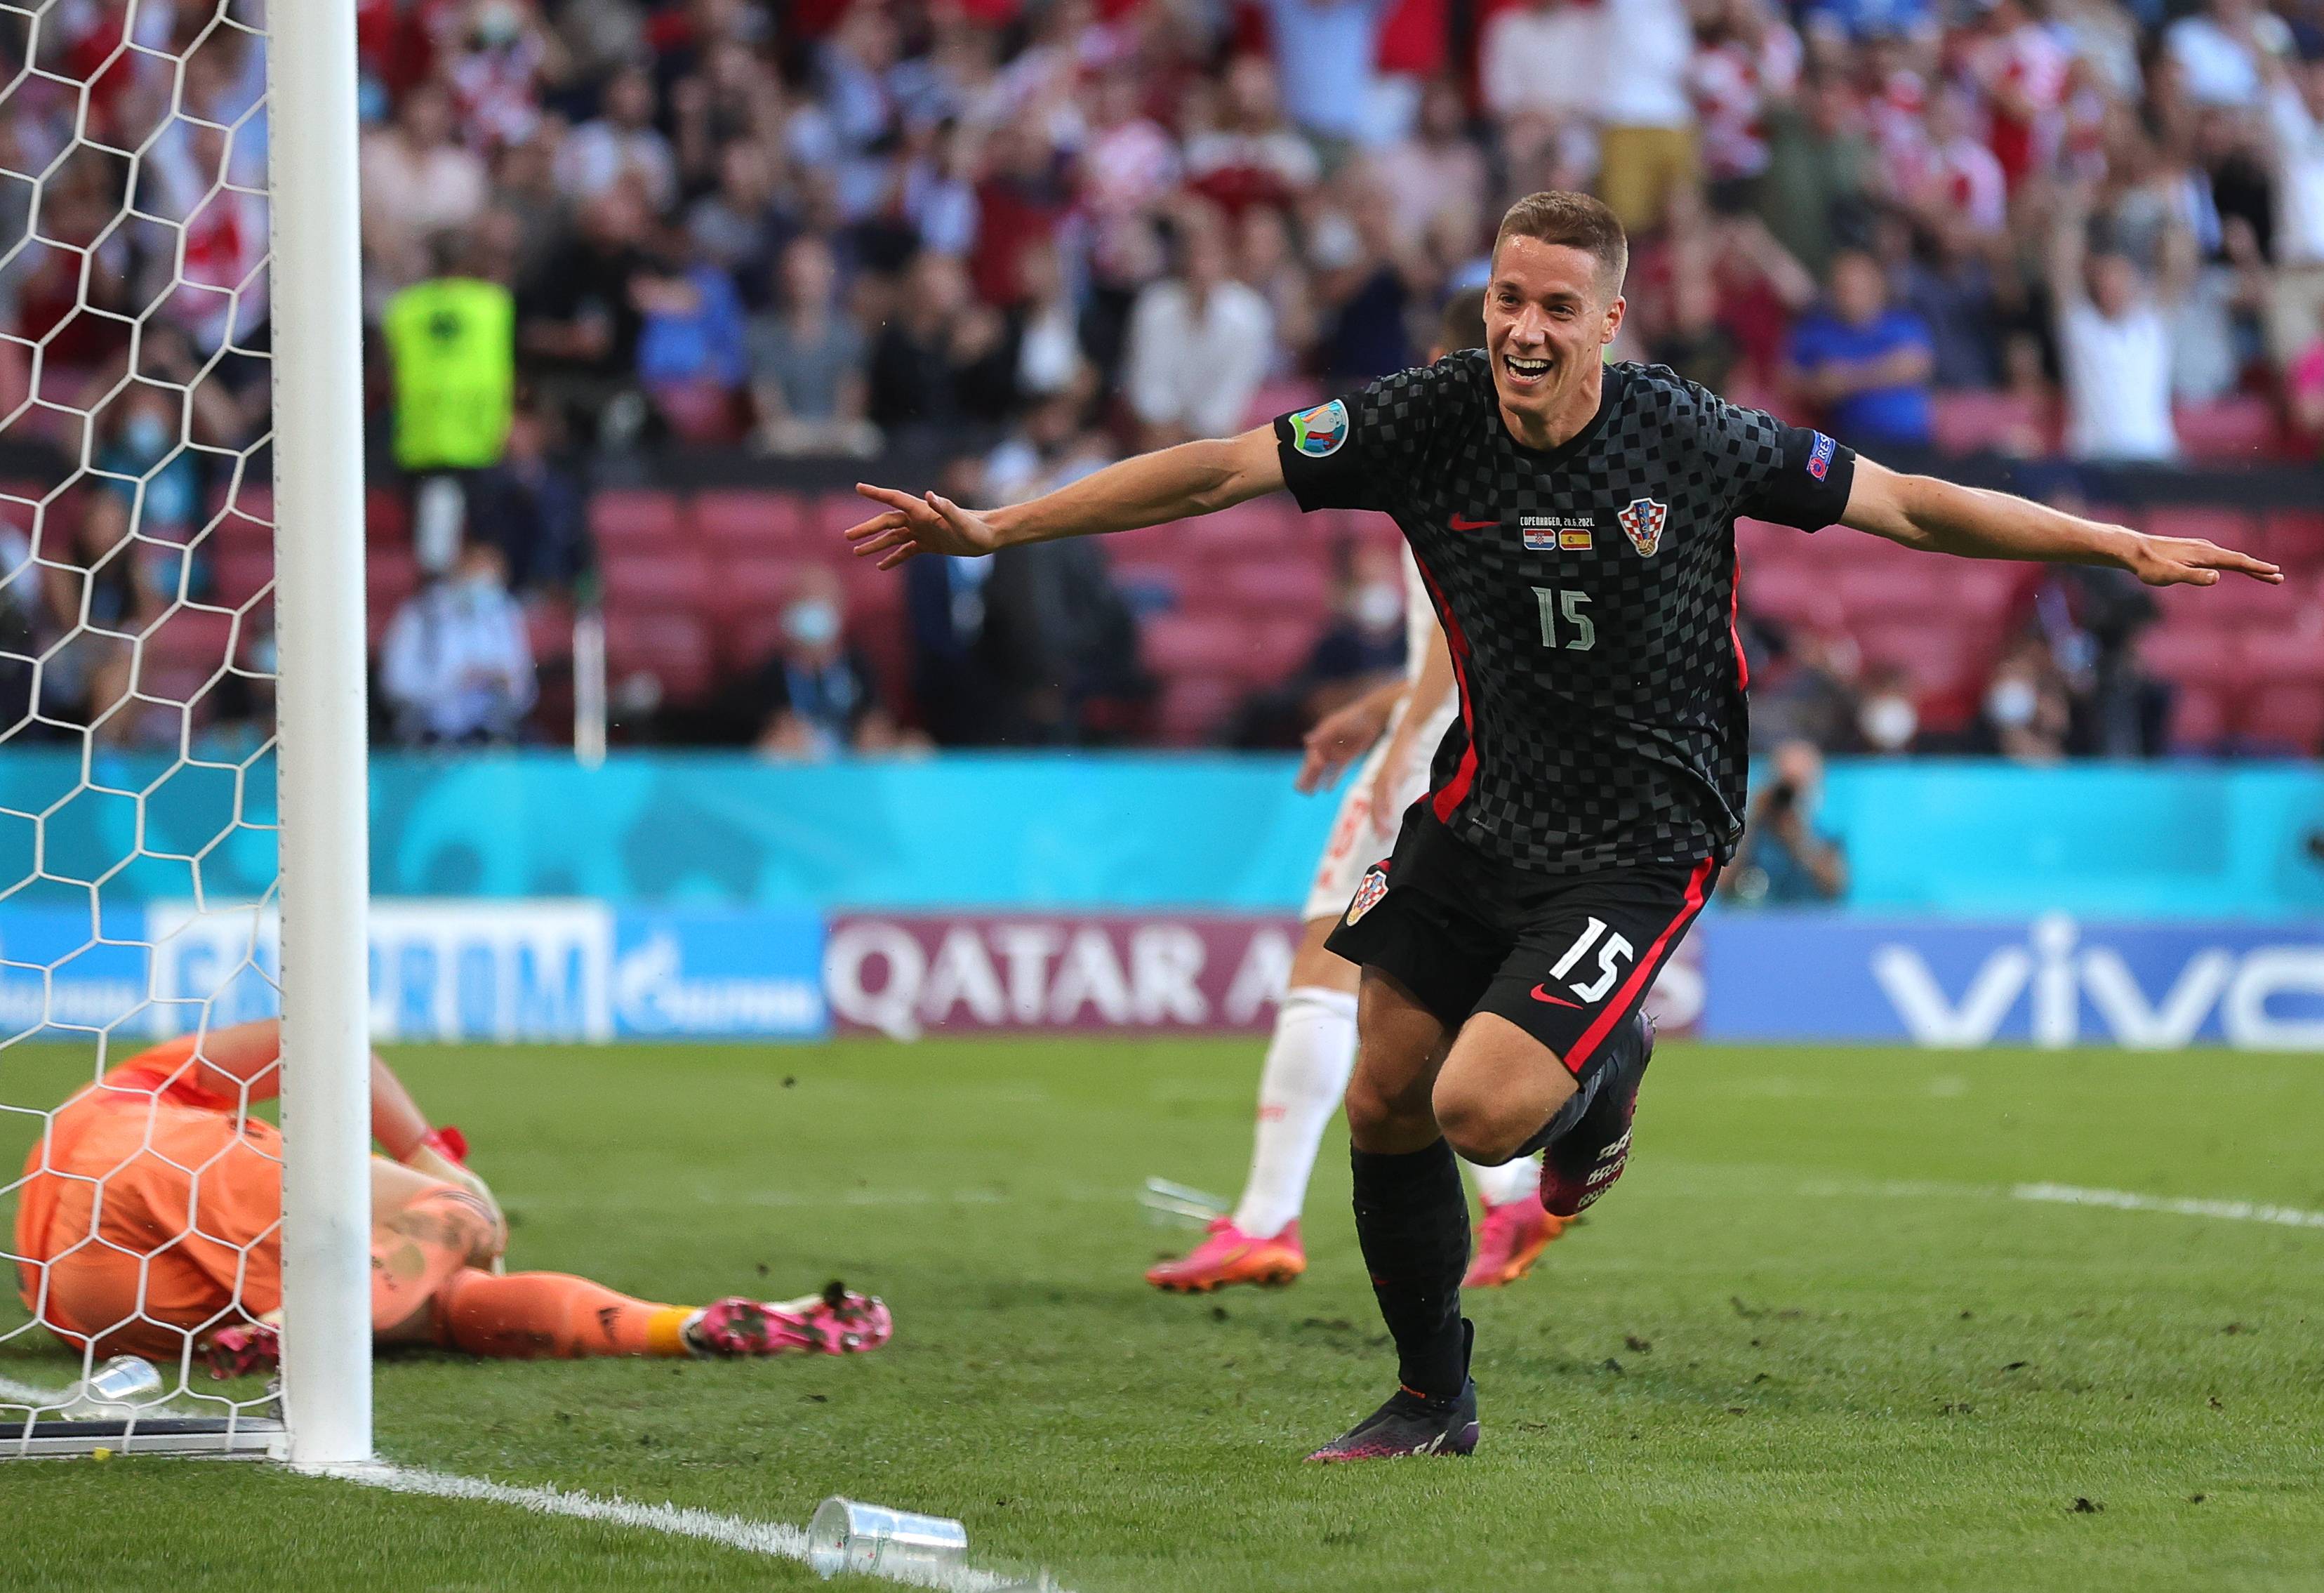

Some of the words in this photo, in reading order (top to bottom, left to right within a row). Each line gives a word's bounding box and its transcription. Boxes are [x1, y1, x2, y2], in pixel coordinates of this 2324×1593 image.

[1520, 516, 1562, 527] COPENHAGEN,
[1530, 586, 1596, 652] 15
[823, 922, 1209, 1043] QATAR
[1548, 916, 1634, 1004] 15
